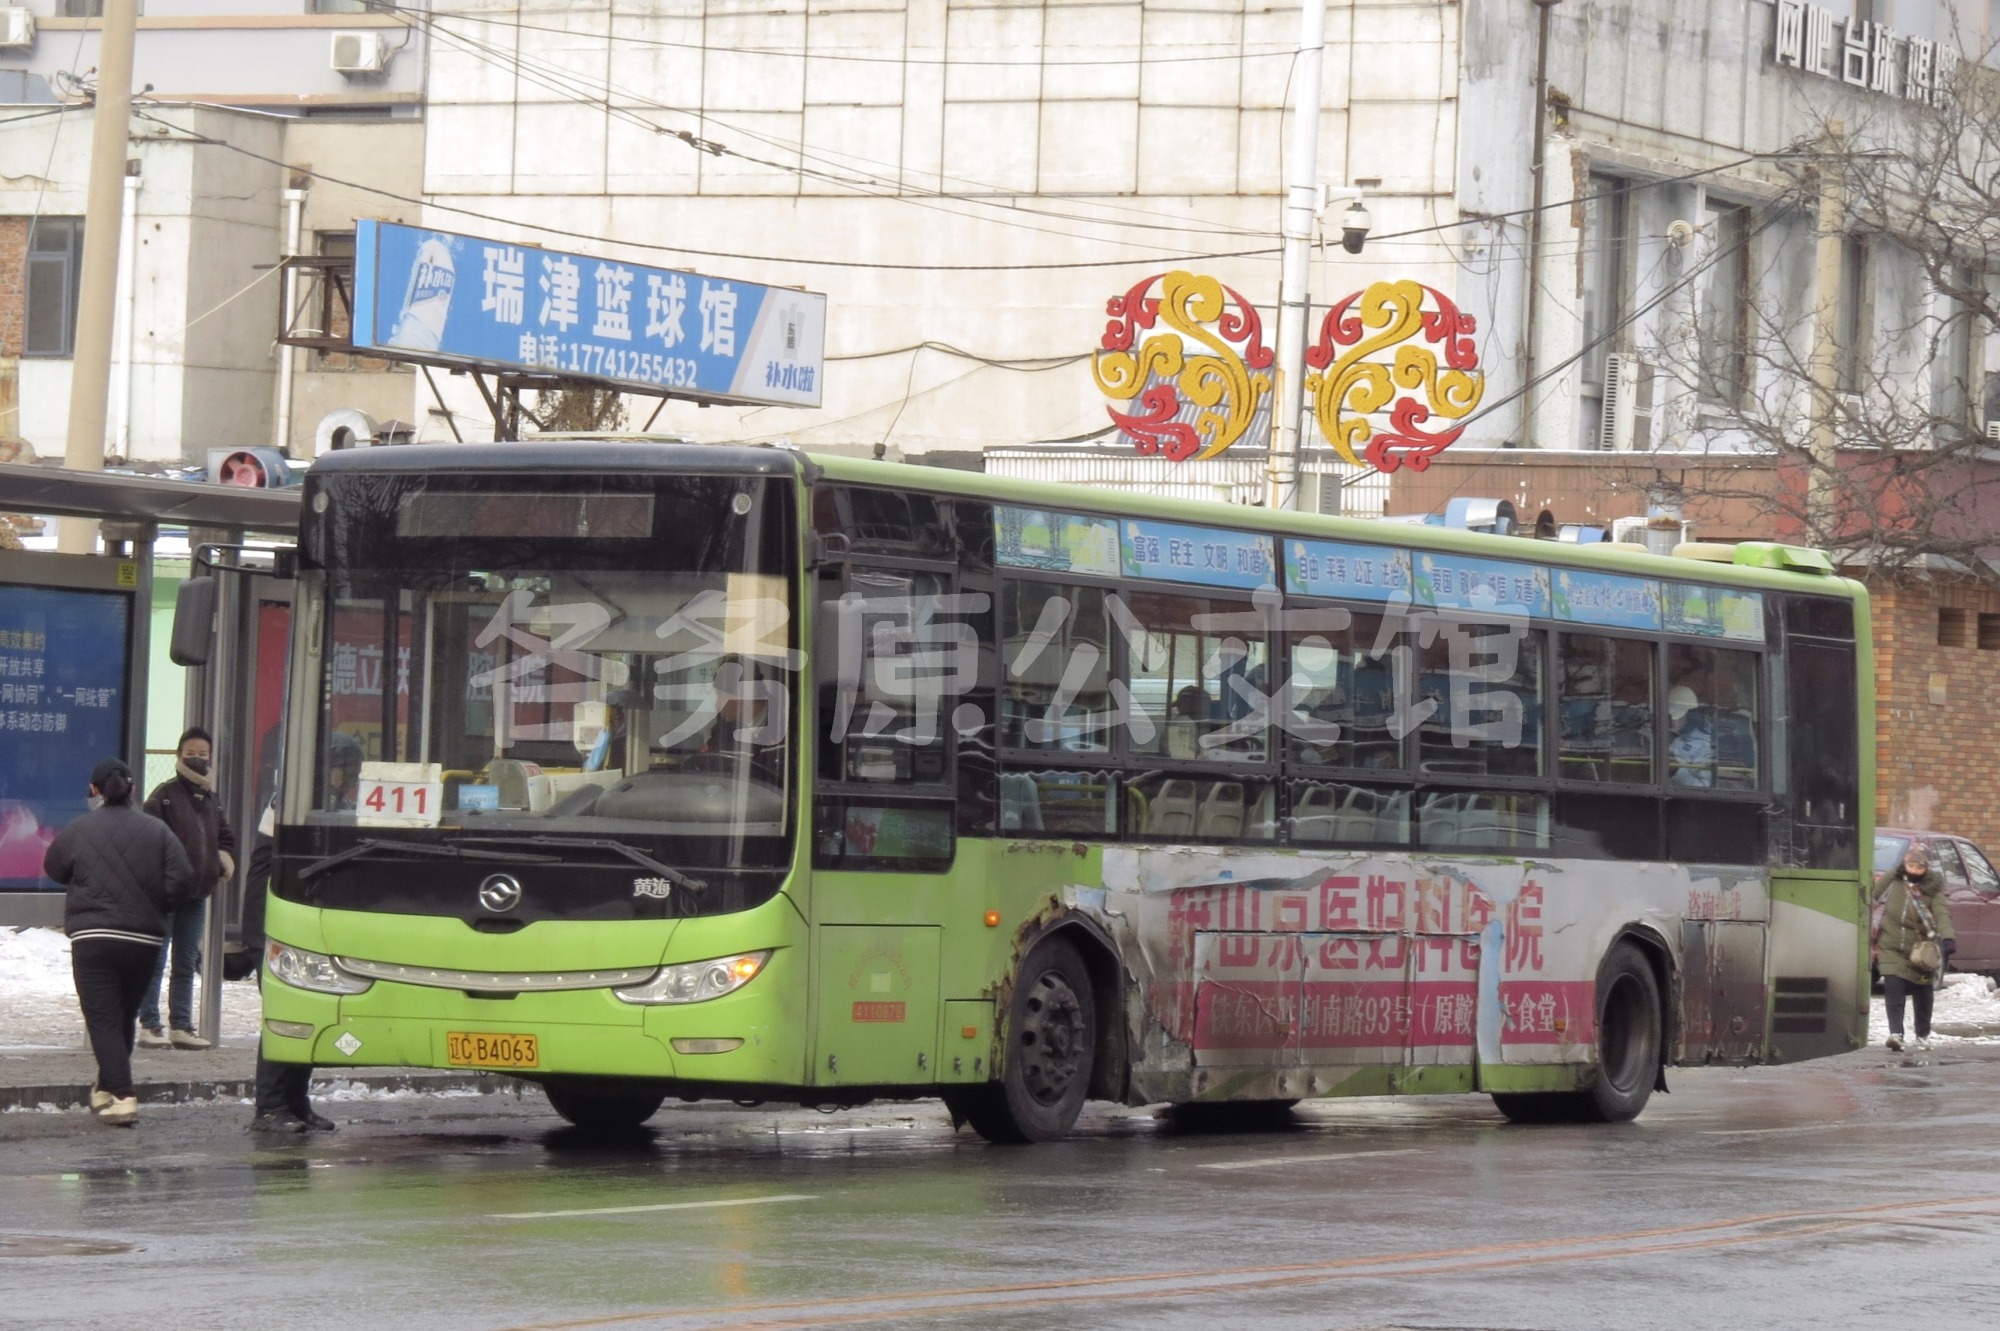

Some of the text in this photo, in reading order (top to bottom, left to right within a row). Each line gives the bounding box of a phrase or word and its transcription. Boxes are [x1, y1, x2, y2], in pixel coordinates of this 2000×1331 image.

[481, 245, 738, 359] 瑞津篮球馆
[518, 331, 698, 389] 电话:17741255432
[766, 361, 815, 392] 补水啦
[1133, 535, 1160, 564] 富强
[1169, 538, 1195, 567] 民主
[1203, 542, 1228, 570] 文明
[1237, 546, 1263, 574] 和谐
[1299, 554, 1400, 588] 自由 平等 公正 法治
[1432, 567, 1453, 593] 爱国
[1513, 577, 1534, 602] 友善
[0, 656, 45, 678] 开放共享
[0, 683, 117, 708] 网协同”、“一网统管”
[365, 785, 428, 815] 411
[633, 877, 672, 899] 黄海
